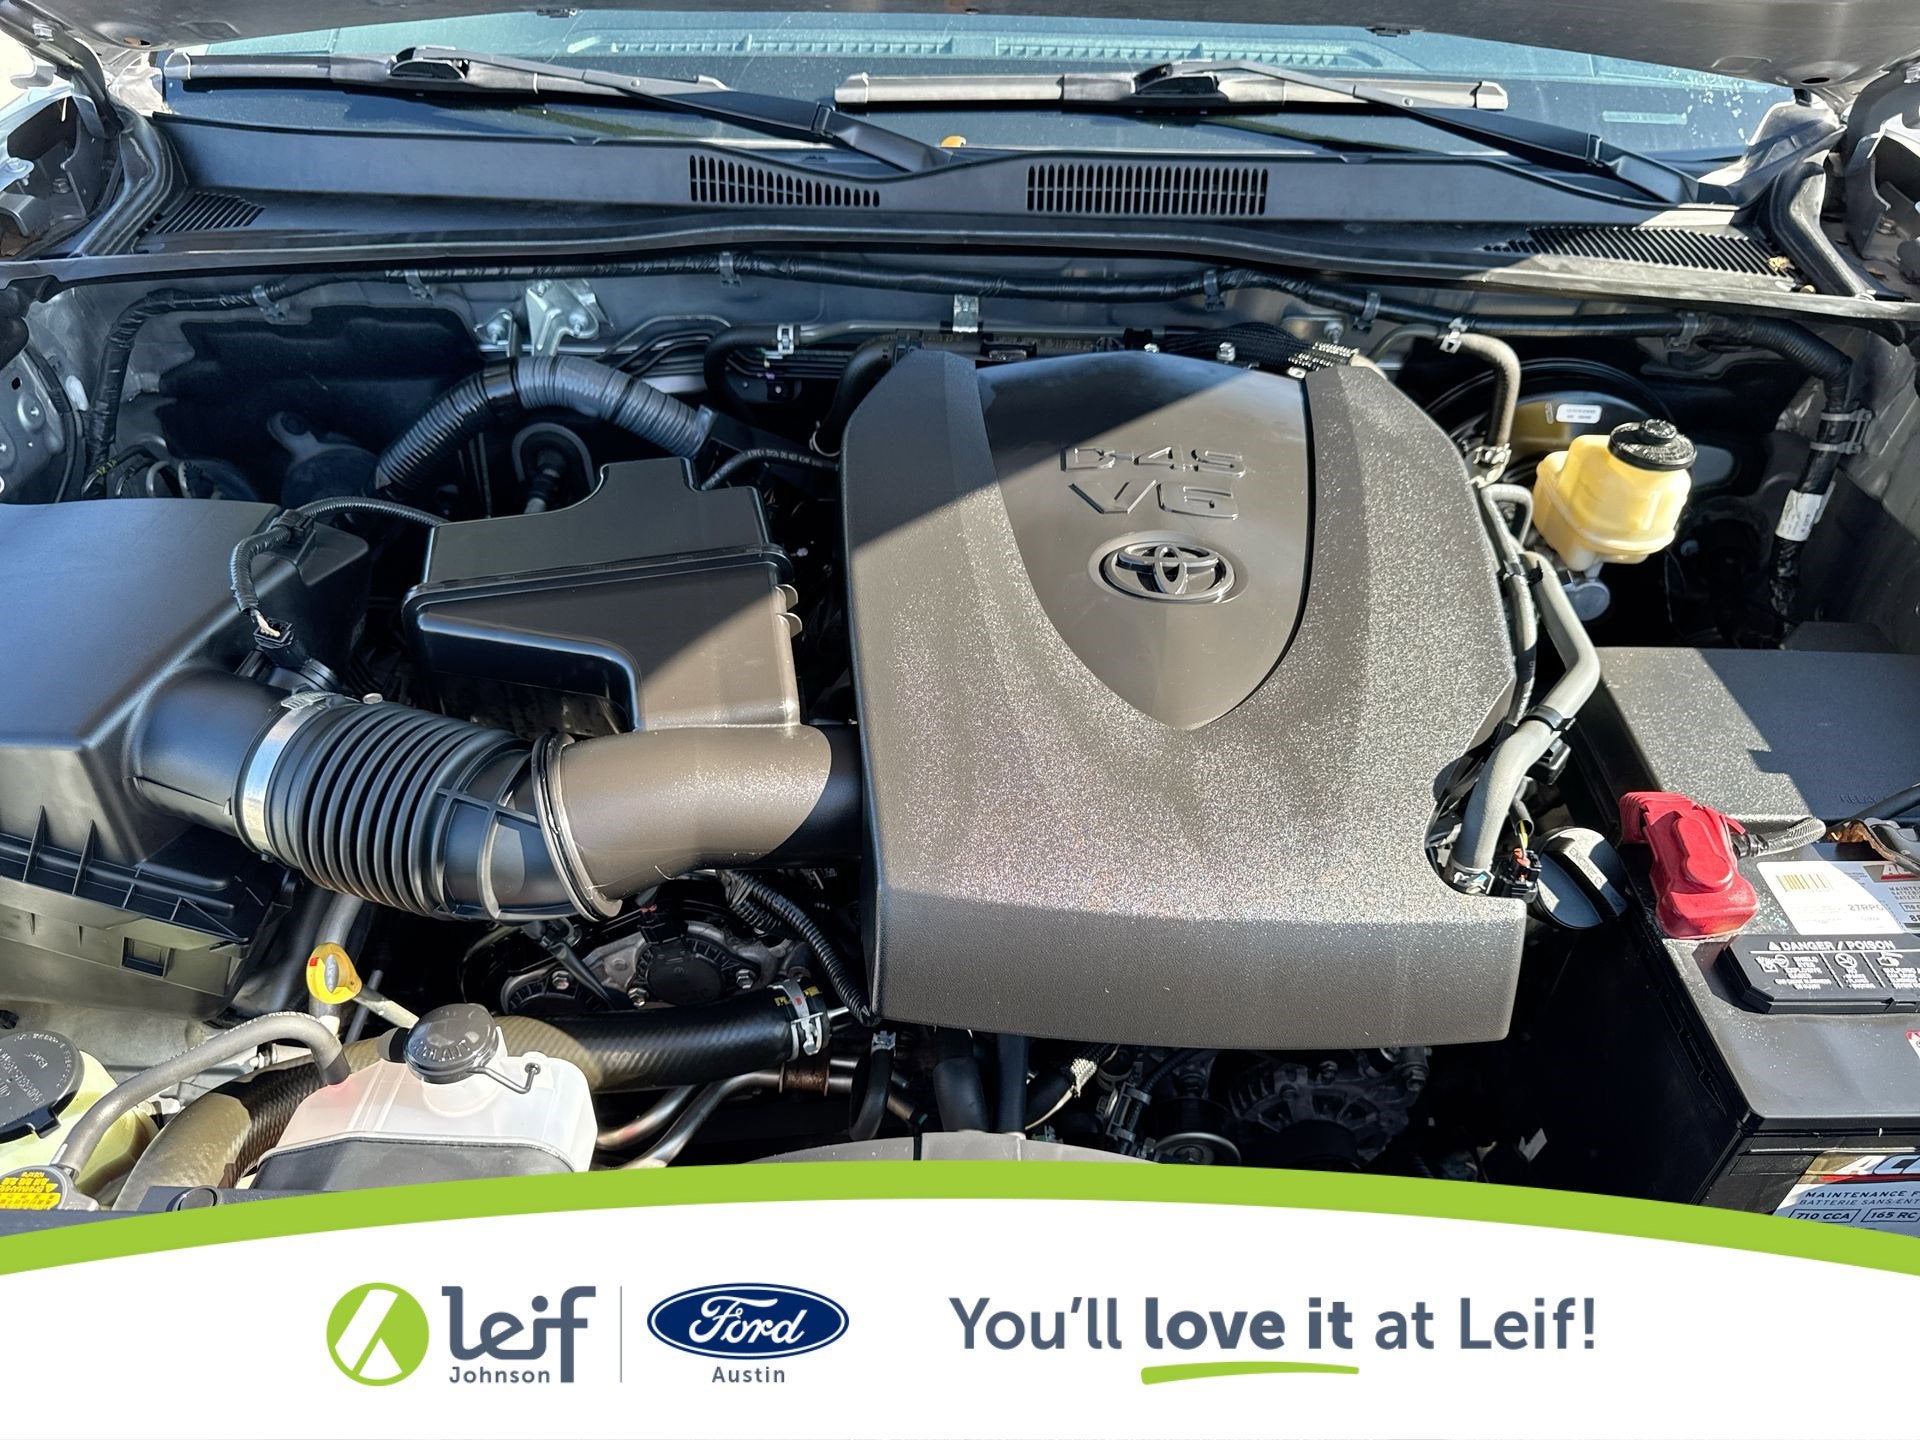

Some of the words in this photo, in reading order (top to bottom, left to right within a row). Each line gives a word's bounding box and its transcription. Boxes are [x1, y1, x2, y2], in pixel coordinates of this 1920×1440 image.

[1068, 479, 1239, 520] V6
[1568, 847, 1597, 878] ENGINE
[1779, 941, 1836, 951] DANGER
[1845, 940, 1896, 950] POISON
[1805, 1190, 1907, 1198] MAINTENANCE
[1796, 1212, 1819, 1220] 710
[1822, 1212, 1850, 1220] CCA
[1870, 1211, 1894, 1219] 165
[1896, 1211, 1918, 1219] RC
